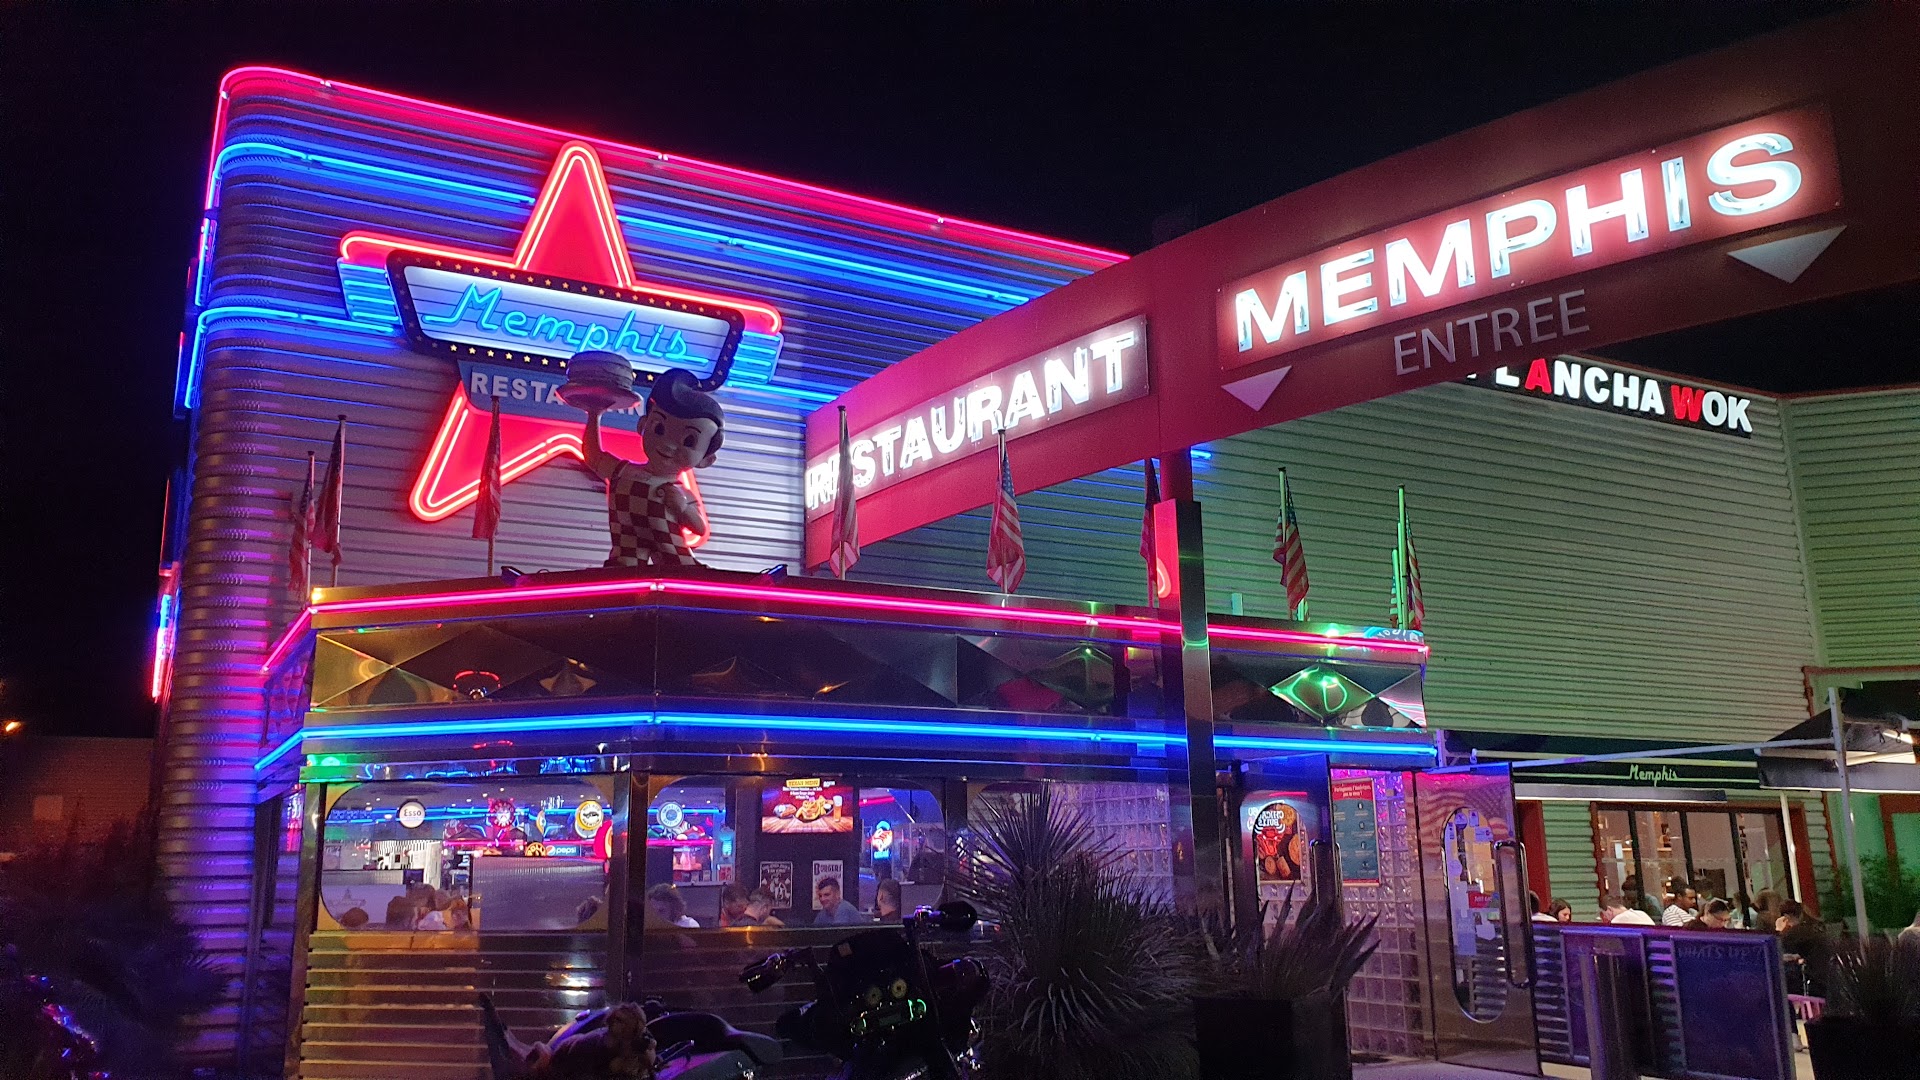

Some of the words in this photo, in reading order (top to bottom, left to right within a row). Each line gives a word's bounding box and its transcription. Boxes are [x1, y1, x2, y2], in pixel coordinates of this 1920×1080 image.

[1235, 131, 1803, 353] MEMPHIS
[421, 281, 709, 365] Memphis
[1393, 288, 1592, 377] ENTREE
[470, 371, 645, 416] RESTAN
[1466, 358, 1665, 416] LANCHA
[1670, 384, 1754, 434] WOK
[1629, 763, 1679, 787] Memphis
[403, 808, 422, 817] Esso
[555, 845, 577, 855] pepsi
